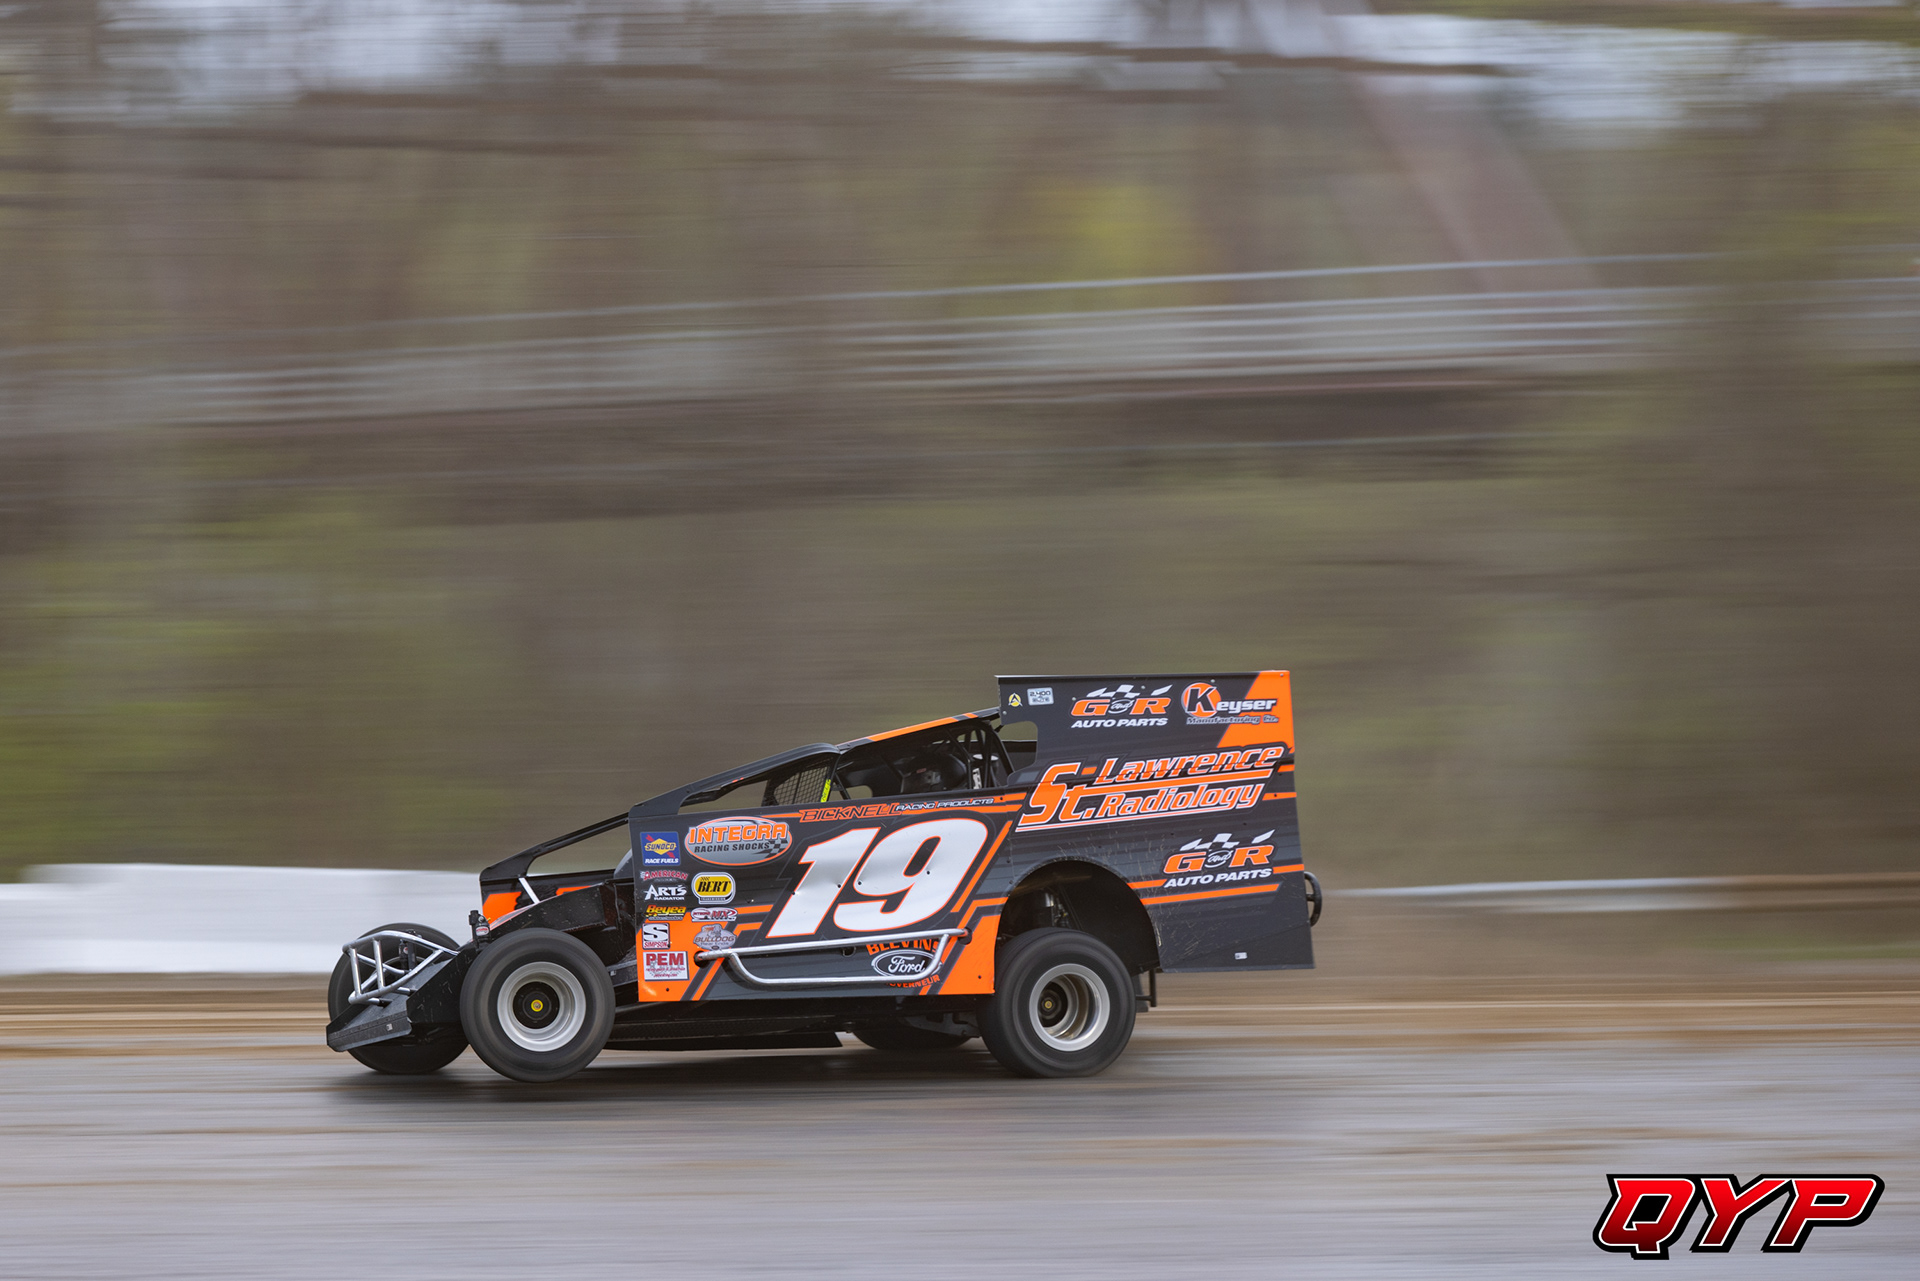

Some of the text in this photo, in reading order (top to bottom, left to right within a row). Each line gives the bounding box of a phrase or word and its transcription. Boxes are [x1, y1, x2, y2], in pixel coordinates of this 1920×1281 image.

[1071, 699, 1111, 717] G
[1129, 697, 1171, 715] R
[1184, 686, 1278, 715] Keyser
[1071, 717, 1169, 729] AUTO PARTS
[1186, 714, 1261, 725] Manufacturing
[800, 797, 995, 822] BICKNELL RACING PRODUCTS
[1096, 783, 1265, 819] Radiology
[689, 823, 788, 844] INTEGRA
[732, 842, 770, 851] SHOCKS
[1163, 851, 1207, 874] G
[1228, 845, 1275, 868] R
[642, 870, 689, 880] AMERICAN
[766, 818, 988, 938] 19
[1164, 868, 1273, 888] AUTO PARTS
[697, 880, 732, 893] BERT
[646, 904, 687, 916] Beyea
[643, 923, 669, 941] S
[694, 935, 735, 943] BULLDOG
[646, 953, 685, 966] PEM
[888, 956, 926, 973] Ford
